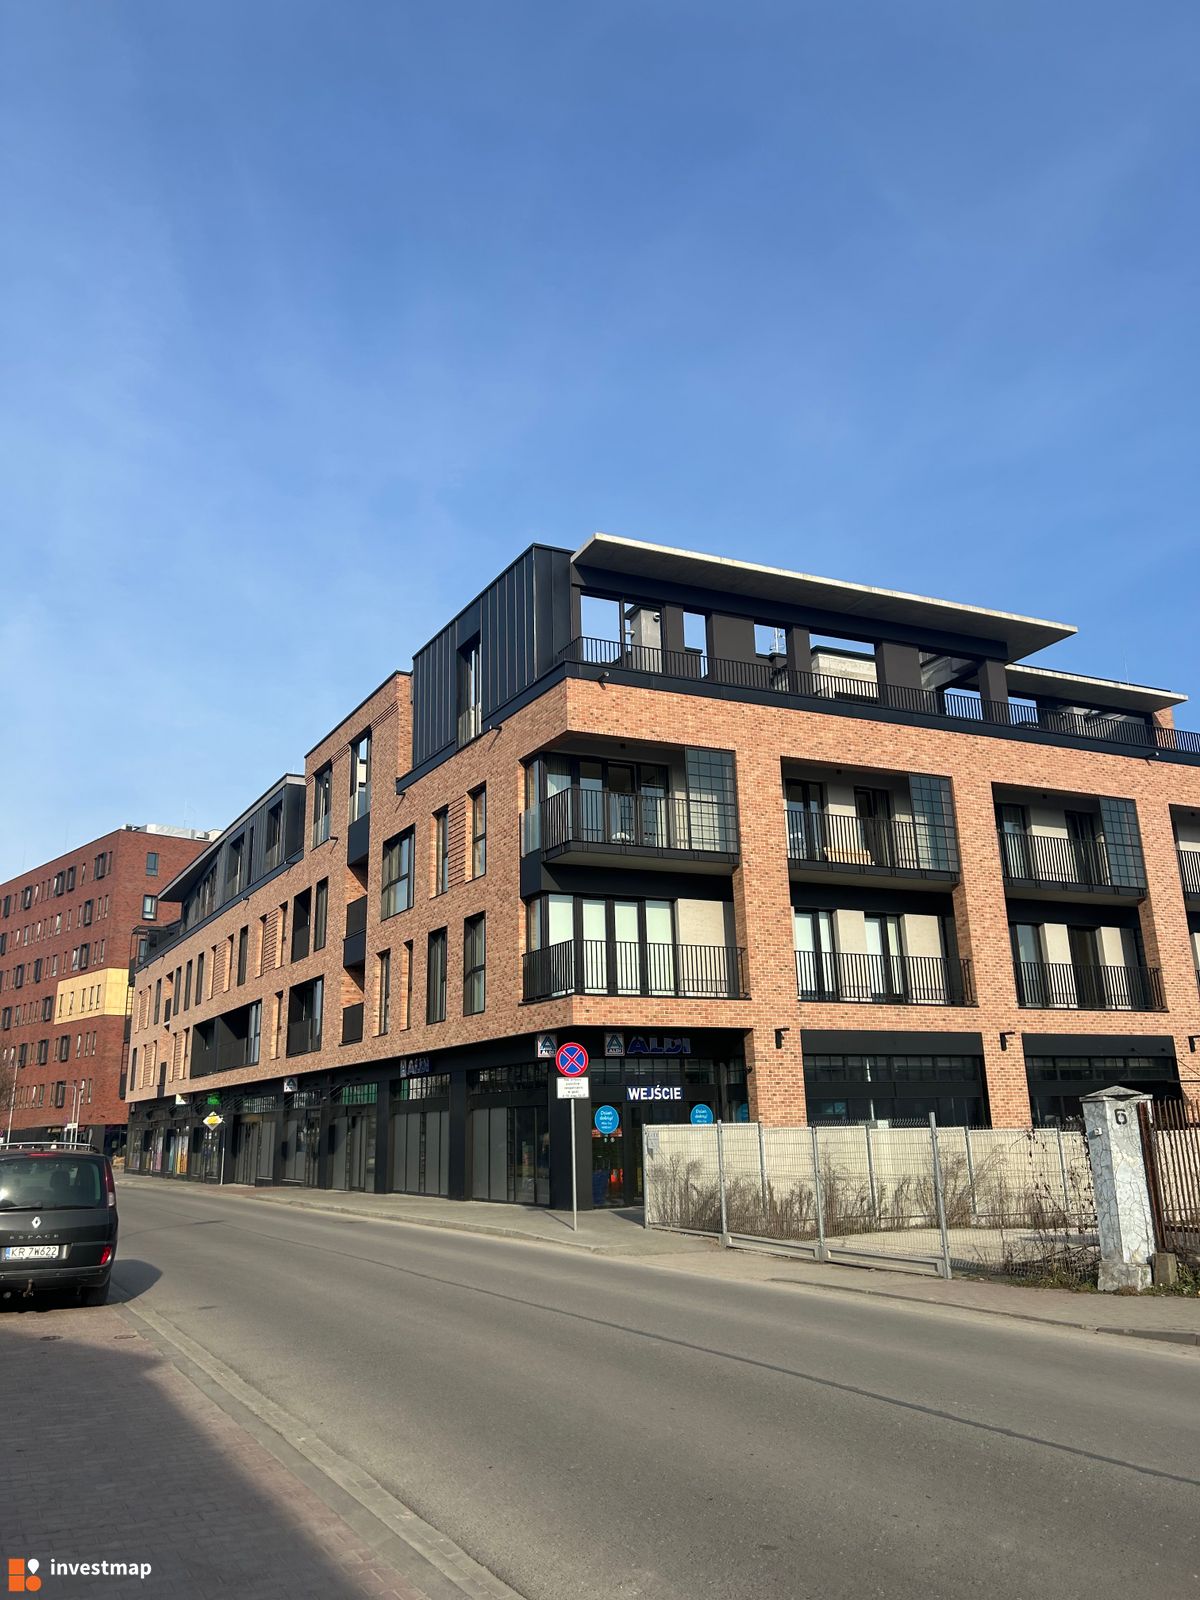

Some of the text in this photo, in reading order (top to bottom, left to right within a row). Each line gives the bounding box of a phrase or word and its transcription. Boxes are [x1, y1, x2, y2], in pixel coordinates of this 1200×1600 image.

[627, 1036, 691, 1054] ALDI
[407, 1058, 430, 1075] ALDI
[628, 1084, 682, 1100] WEJŚCIE
[1114, 1108, 1127, 1125] 6
[11, 1246, 57, 1257] KR 7W622
